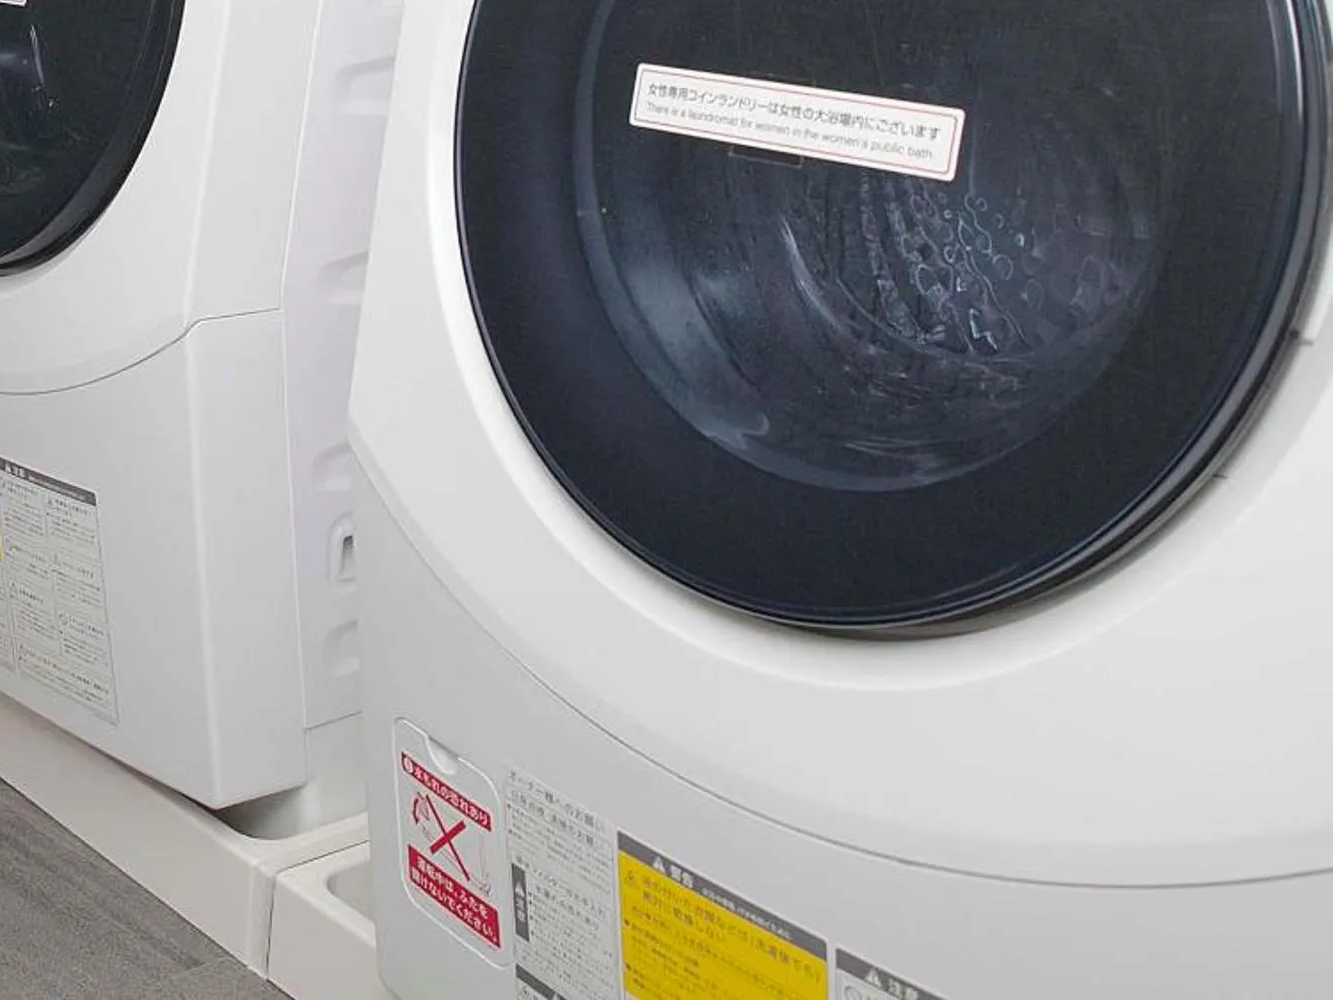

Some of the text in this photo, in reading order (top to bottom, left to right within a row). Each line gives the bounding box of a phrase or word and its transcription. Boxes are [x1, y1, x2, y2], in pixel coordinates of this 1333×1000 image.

[688, 109, 739, 126] laundromat
[755, 122, 790, 137] women
[907, 146, 934, 158] bath
